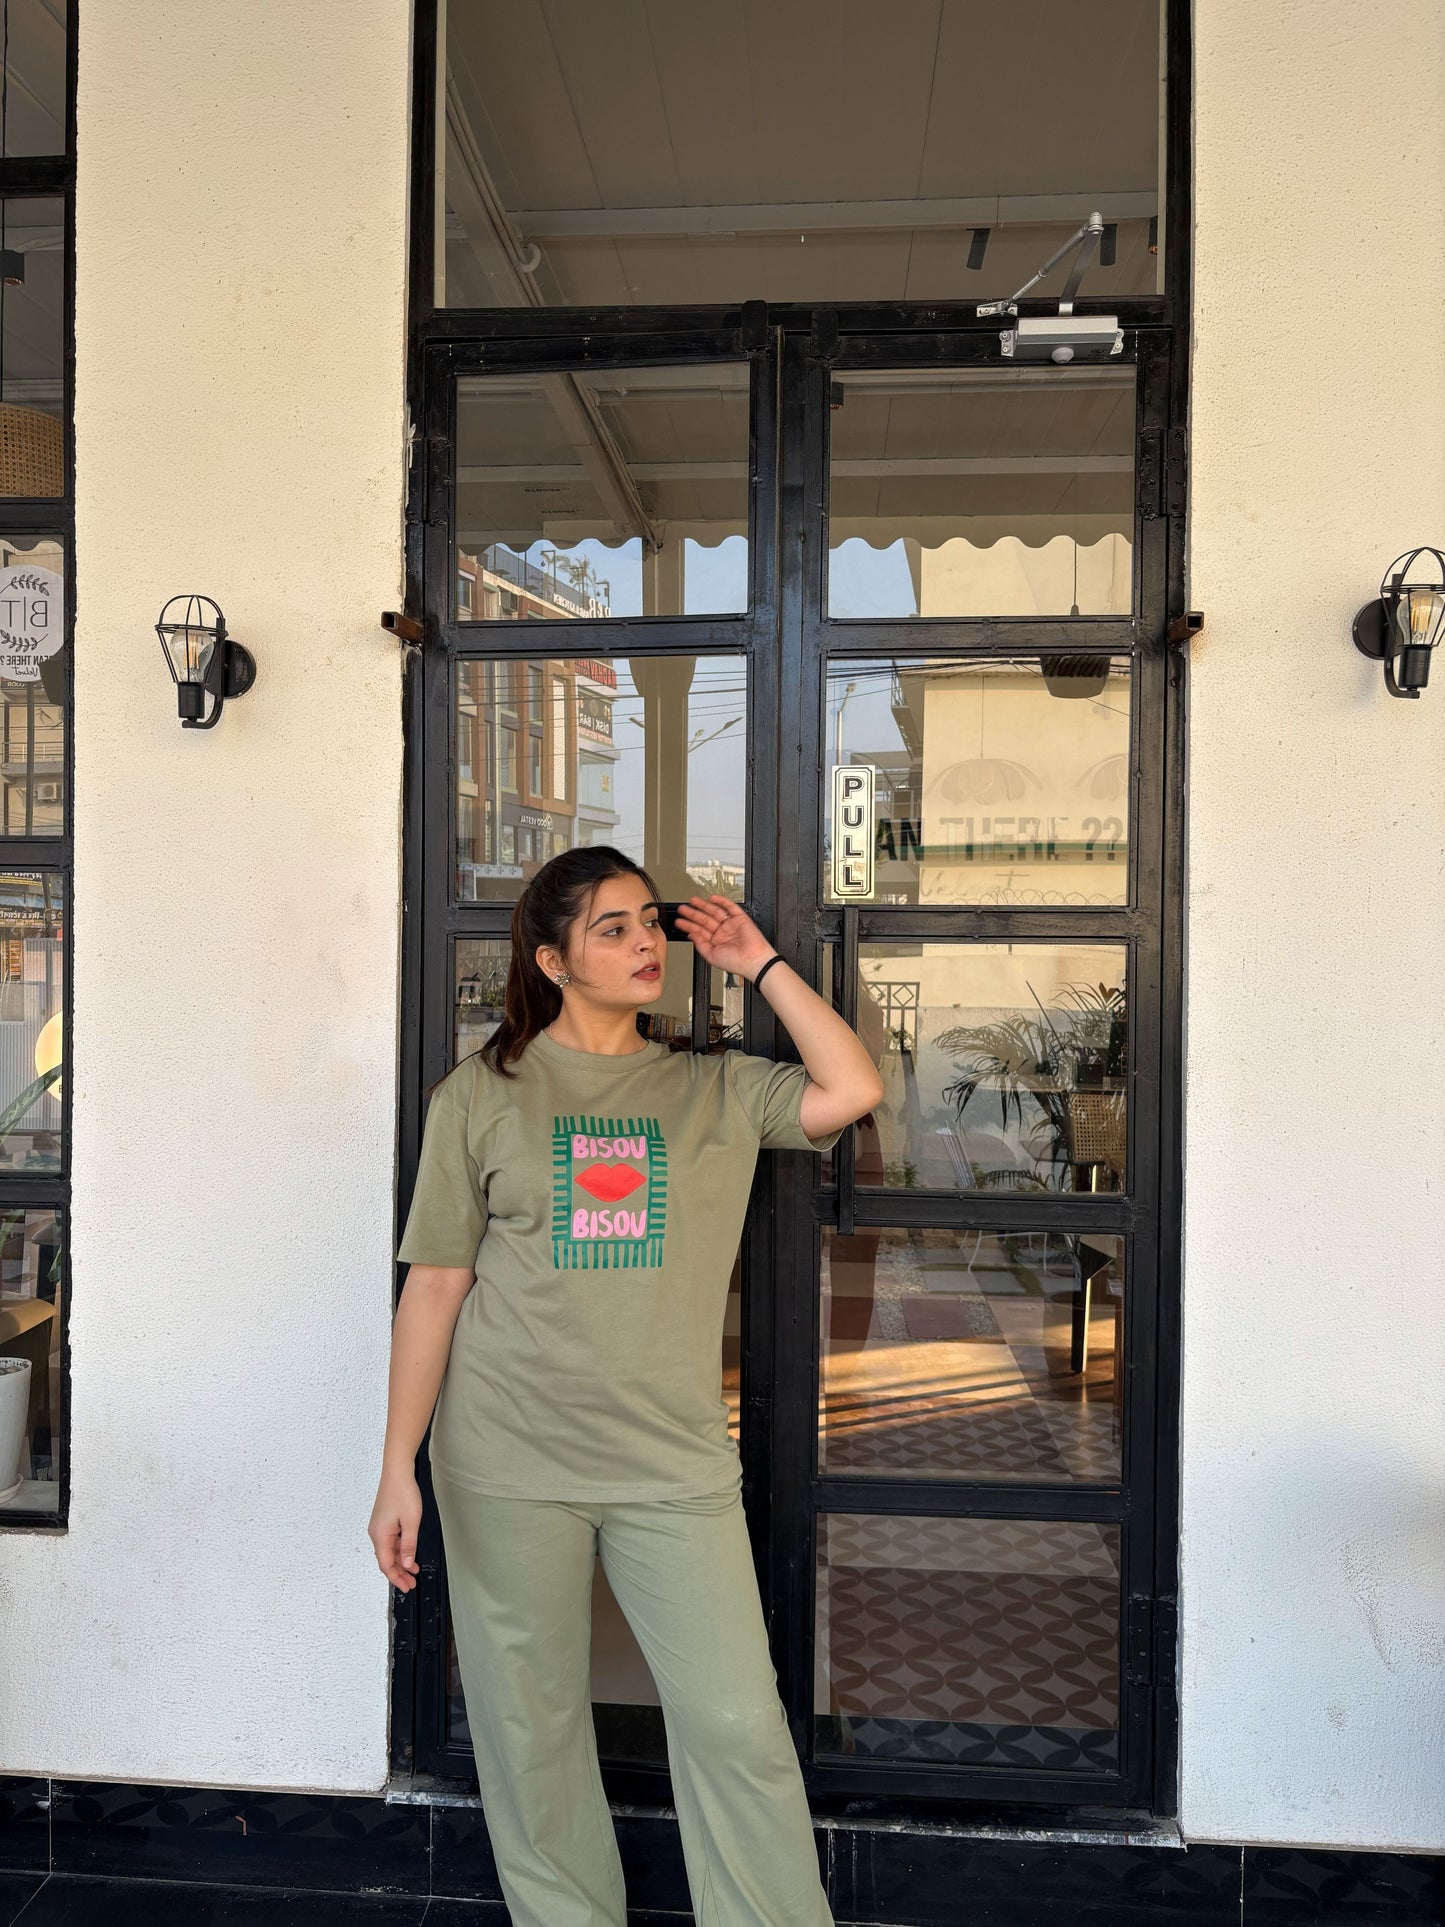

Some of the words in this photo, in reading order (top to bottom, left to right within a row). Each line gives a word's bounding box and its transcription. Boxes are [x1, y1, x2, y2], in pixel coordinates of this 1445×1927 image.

[842, 776, 865, 887] PULL
[939, 816, 1069, 861] THERE
[1081, 816, 1124, 861] ??
[572, 1134, 647, 1160] BISOU
[572, 1208, 647, 1239] BISOU
